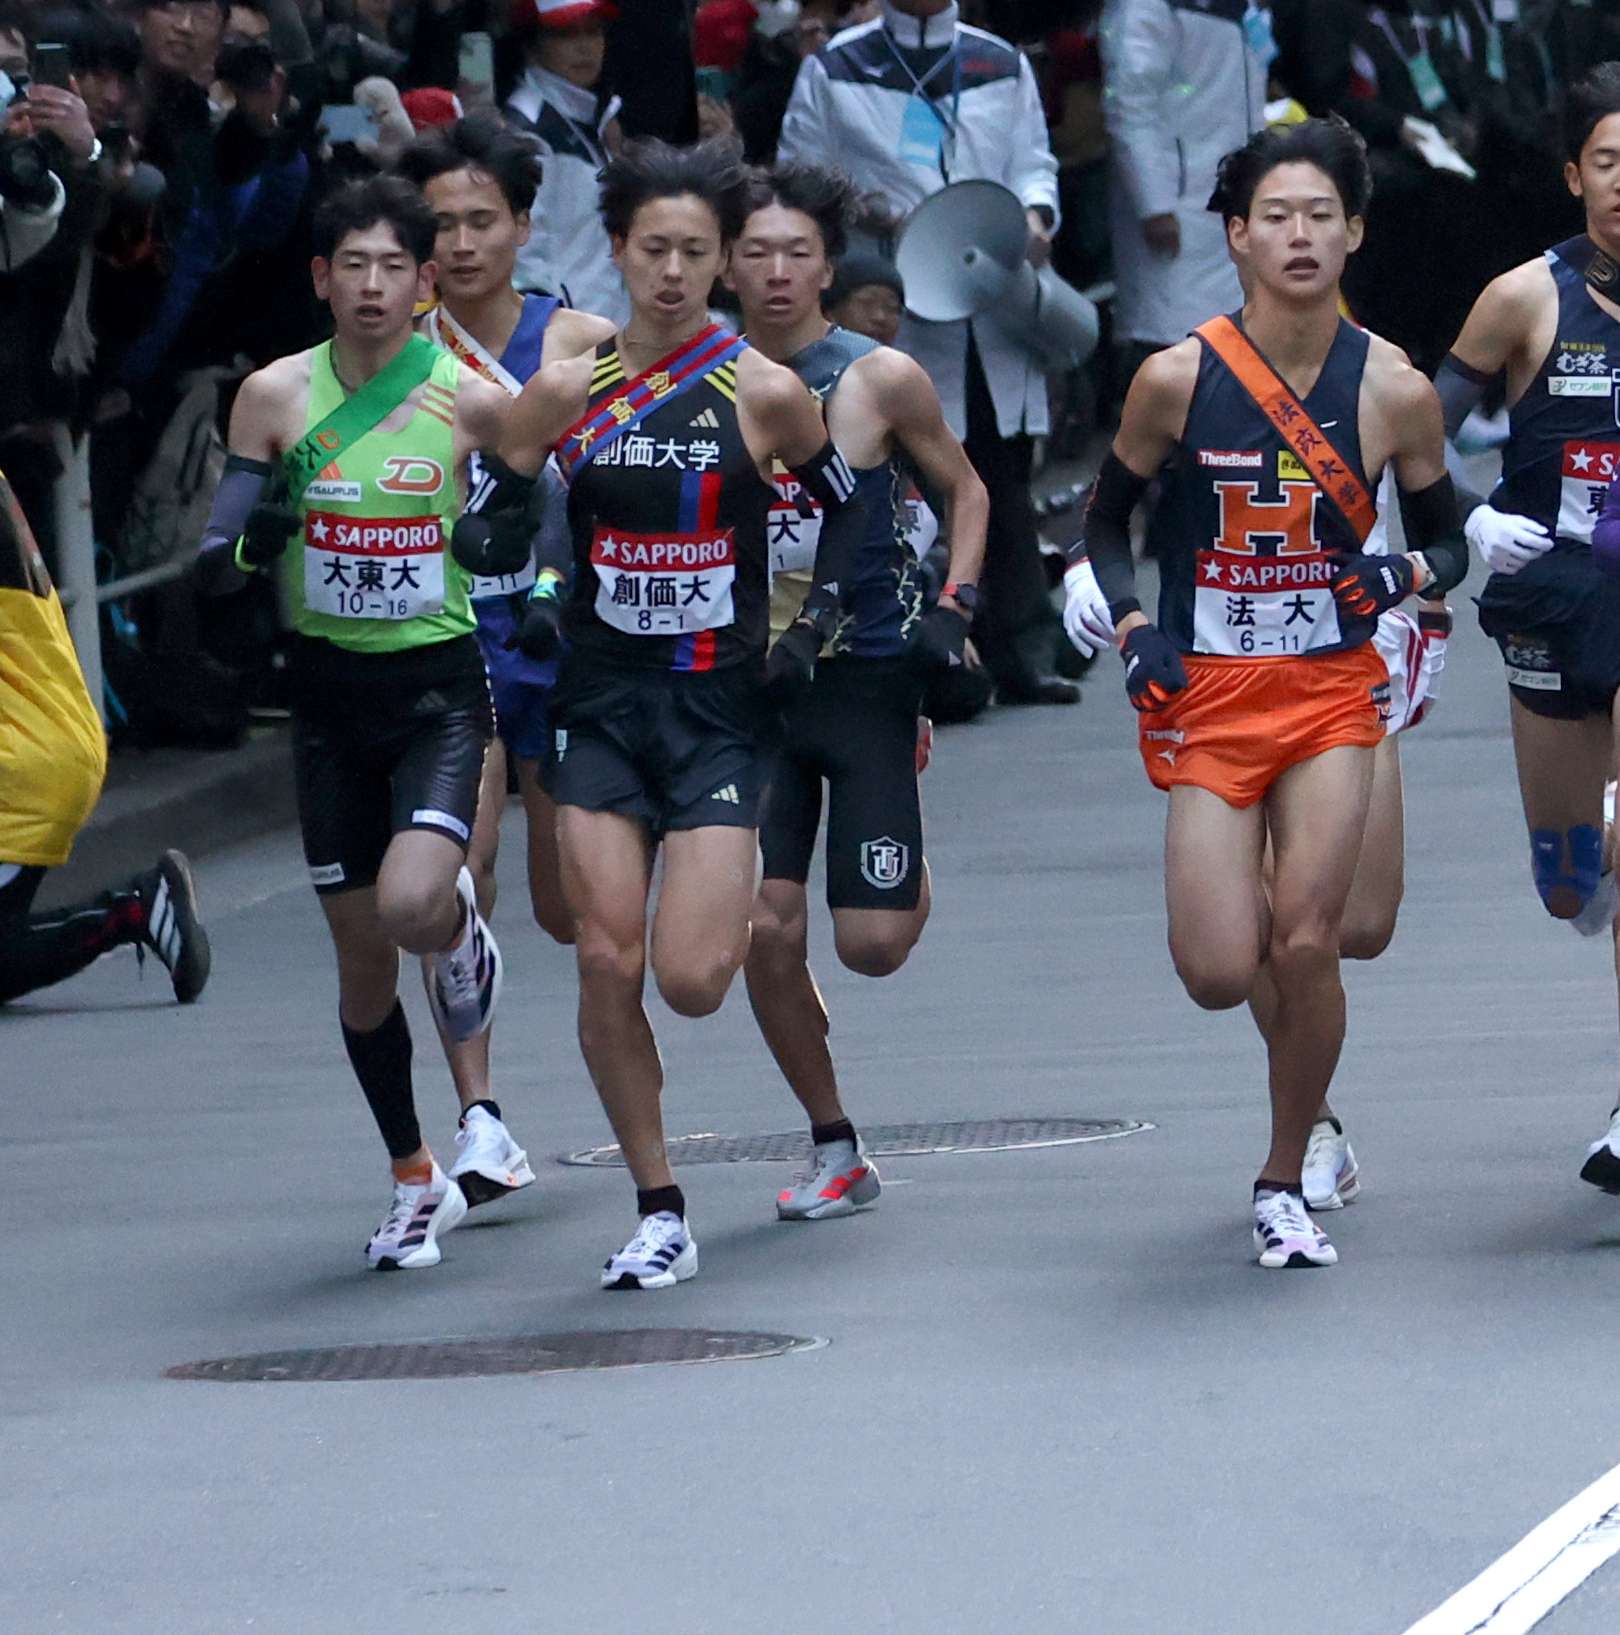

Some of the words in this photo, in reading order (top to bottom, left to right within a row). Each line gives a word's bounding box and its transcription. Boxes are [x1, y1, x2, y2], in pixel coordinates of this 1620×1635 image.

[593, 433, 721, 472] 創価大学
[1200, 452, 1263, 467] ThreeBond
[1214, 480, 1323, 556] H
[334, 524, 439, 549] SAPPORO
[621, 539, 729, 565] SAPPORO
[323, 556, 421, 591] 大東大
[612, 574, 711, 607] 創価大
[338, 592, 408, 615] 10-16
[638, 610, 685, 630] 8-1
[1240, 629, 1300, 652] 6-11
